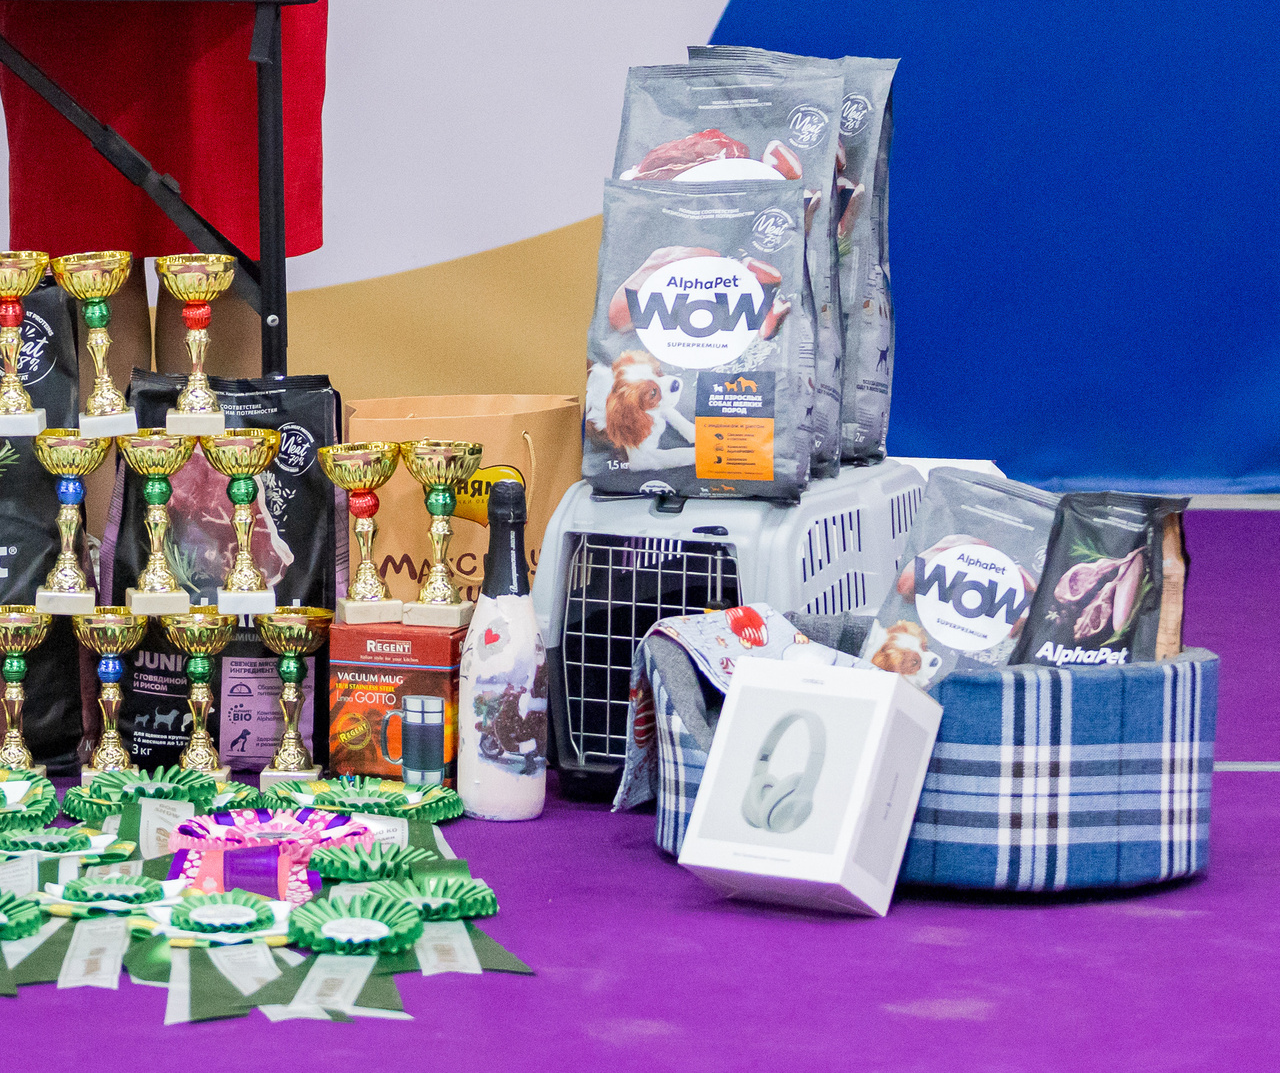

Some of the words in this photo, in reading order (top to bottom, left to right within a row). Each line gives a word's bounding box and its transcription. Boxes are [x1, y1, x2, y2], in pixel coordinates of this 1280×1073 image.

[666, 275, 739, 291] AlphaPet
[281, 433, 311, 456] Meat
[606, 460, 619, 470] 1,5
[956, 553, 1007, 576] AlphaPet
[936, 617, 988, 640] SUPERPREMIUM
[366, 640, 410, 653] REGENT
[1035, 641, 1128, 665] AlphaPet
[140, 673, 187, 685] ГОВЯДИНОЙ
[337, 672, 378, 683] VACUUM
[380, 675, 404, 684] MUG
[141, 682, 168, 692] РИСОМ
[354, 692, 397, 705] GOTTO
[233, 713, 252, 722] BIO
[339, 723, 368, 743] REGENT
[132, 743, 139, 755] 3
